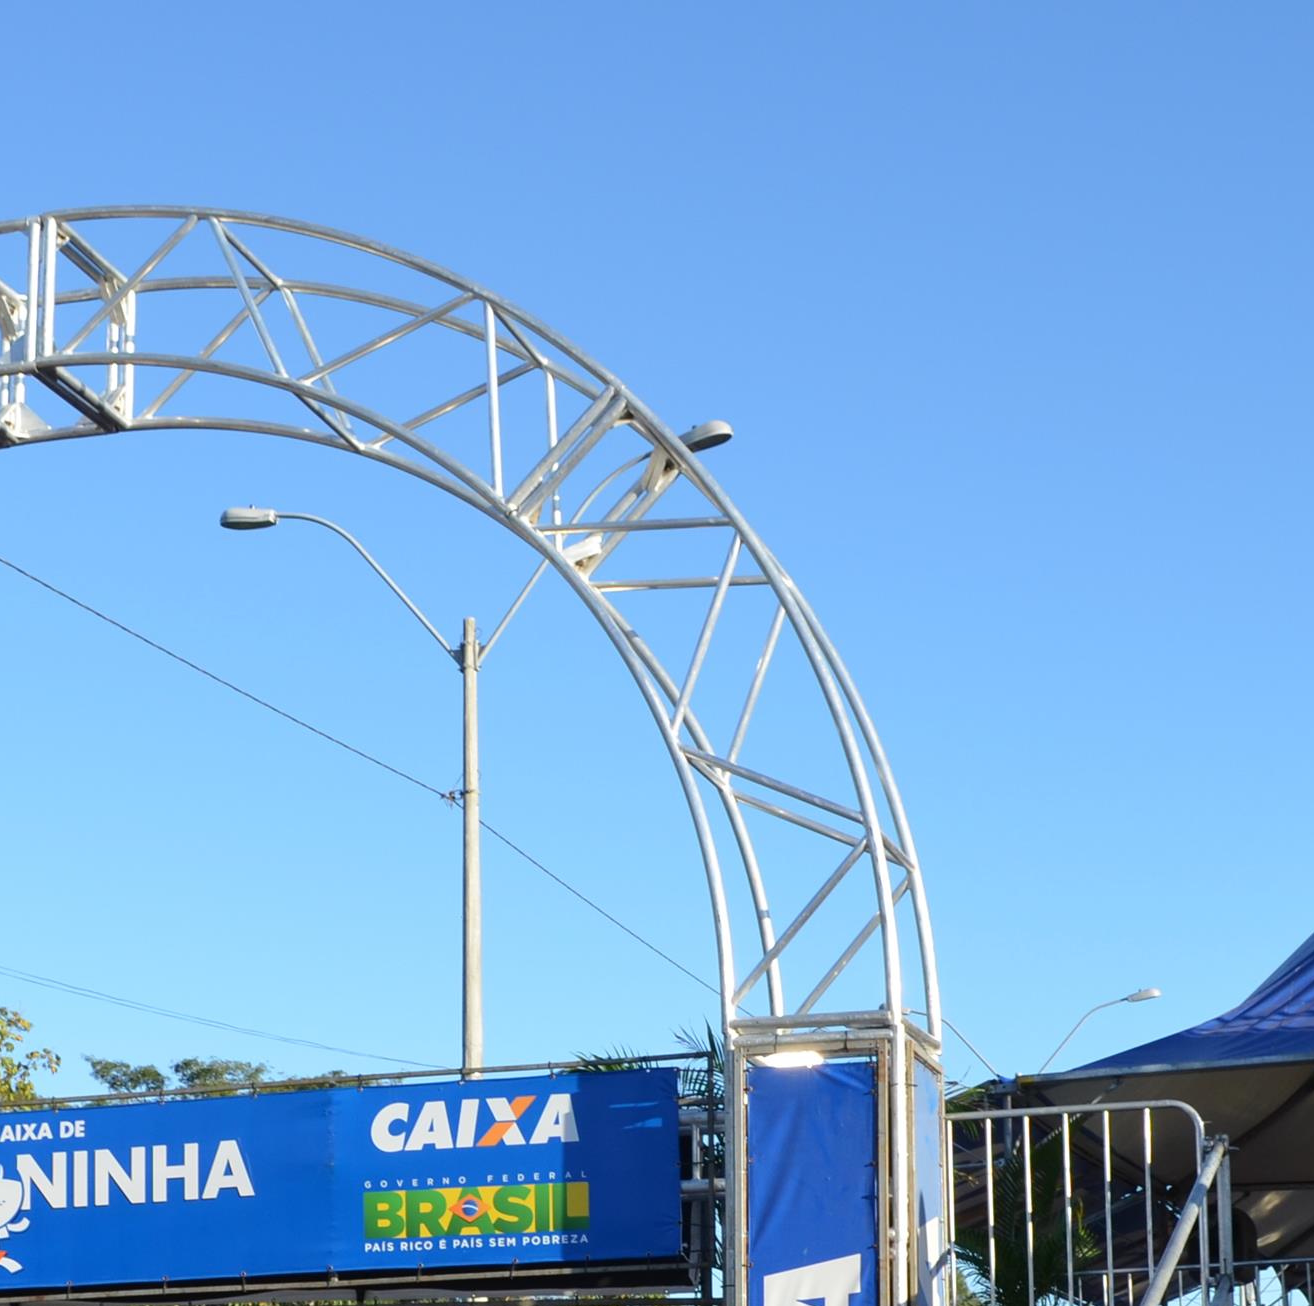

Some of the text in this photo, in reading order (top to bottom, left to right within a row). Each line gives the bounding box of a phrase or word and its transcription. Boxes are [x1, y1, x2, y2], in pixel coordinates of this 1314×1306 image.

[59, 1120, 85, 1138] DE
[370, 1093, 580, 1153] CAIXA
[364, 1170, 587, 1189] GOVERNO FEDERAL
[363, 1181, 589, 1239] BRASIL
[364, 1233, 589, 1253] PAÍS RICO É PAÍS SEM POBREZA
